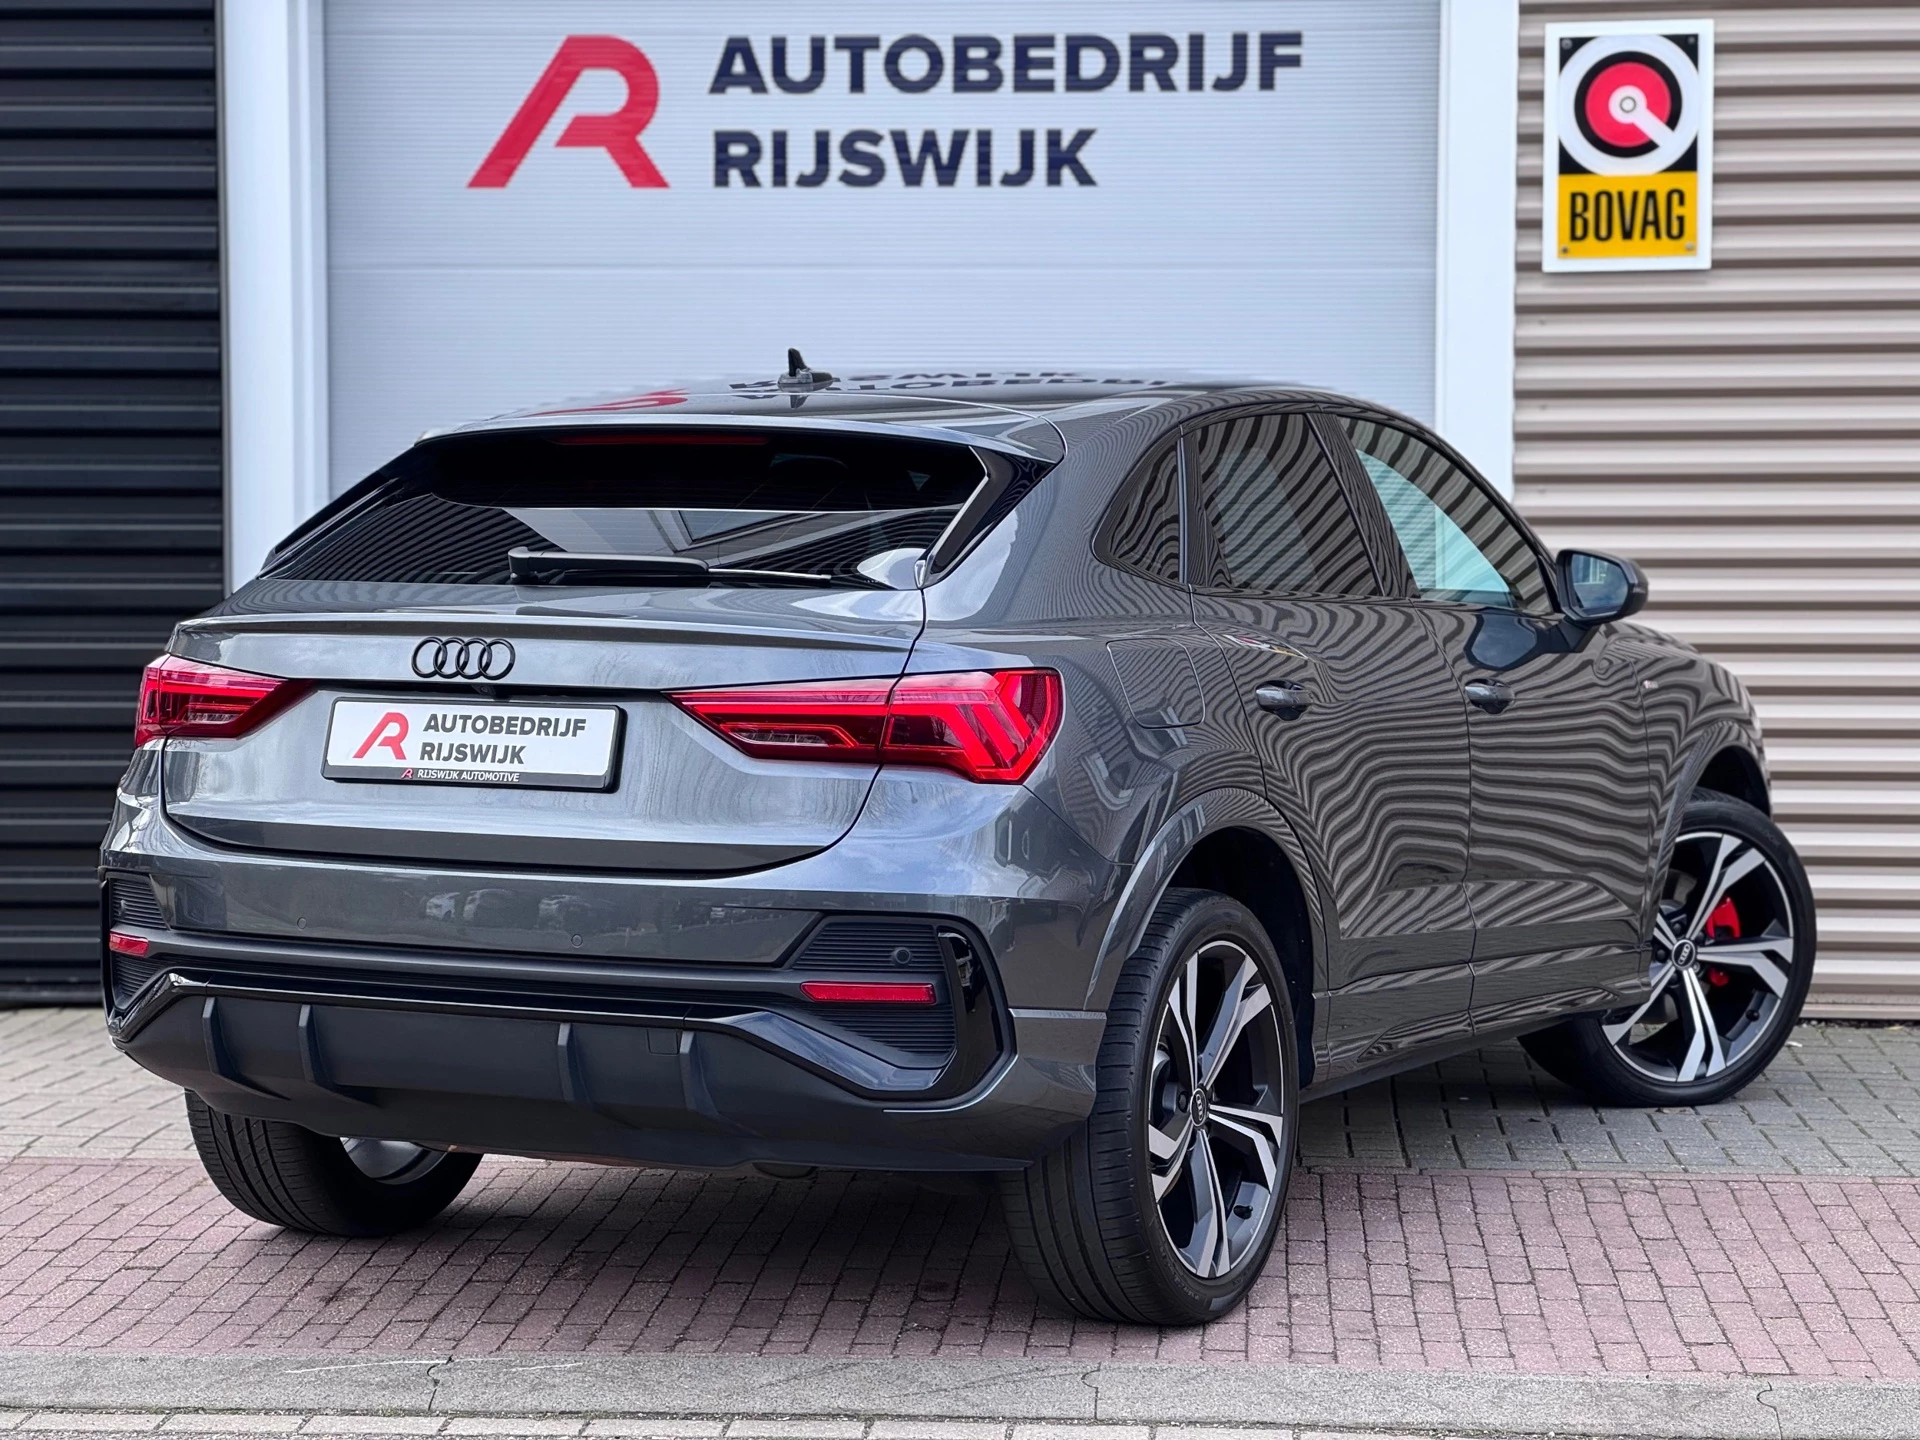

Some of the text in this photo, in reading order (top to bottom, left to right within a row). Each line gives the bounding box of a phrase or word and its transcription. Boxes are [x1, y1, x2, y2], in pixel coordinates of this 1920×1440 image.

[708, 31, 1303, 94] AUTOBEDRIJF
[713, 129, 1099, 188] RIJSWIJK
[1569, 188, 1686, 242] BOVAG
[423, 713, 587, 738] AUTOBEDRIJF
[419, 742, 526, 764] RIJSWIJK
[417, 769, 520, 782] RIJSWIJK AUTOMOTIVE
